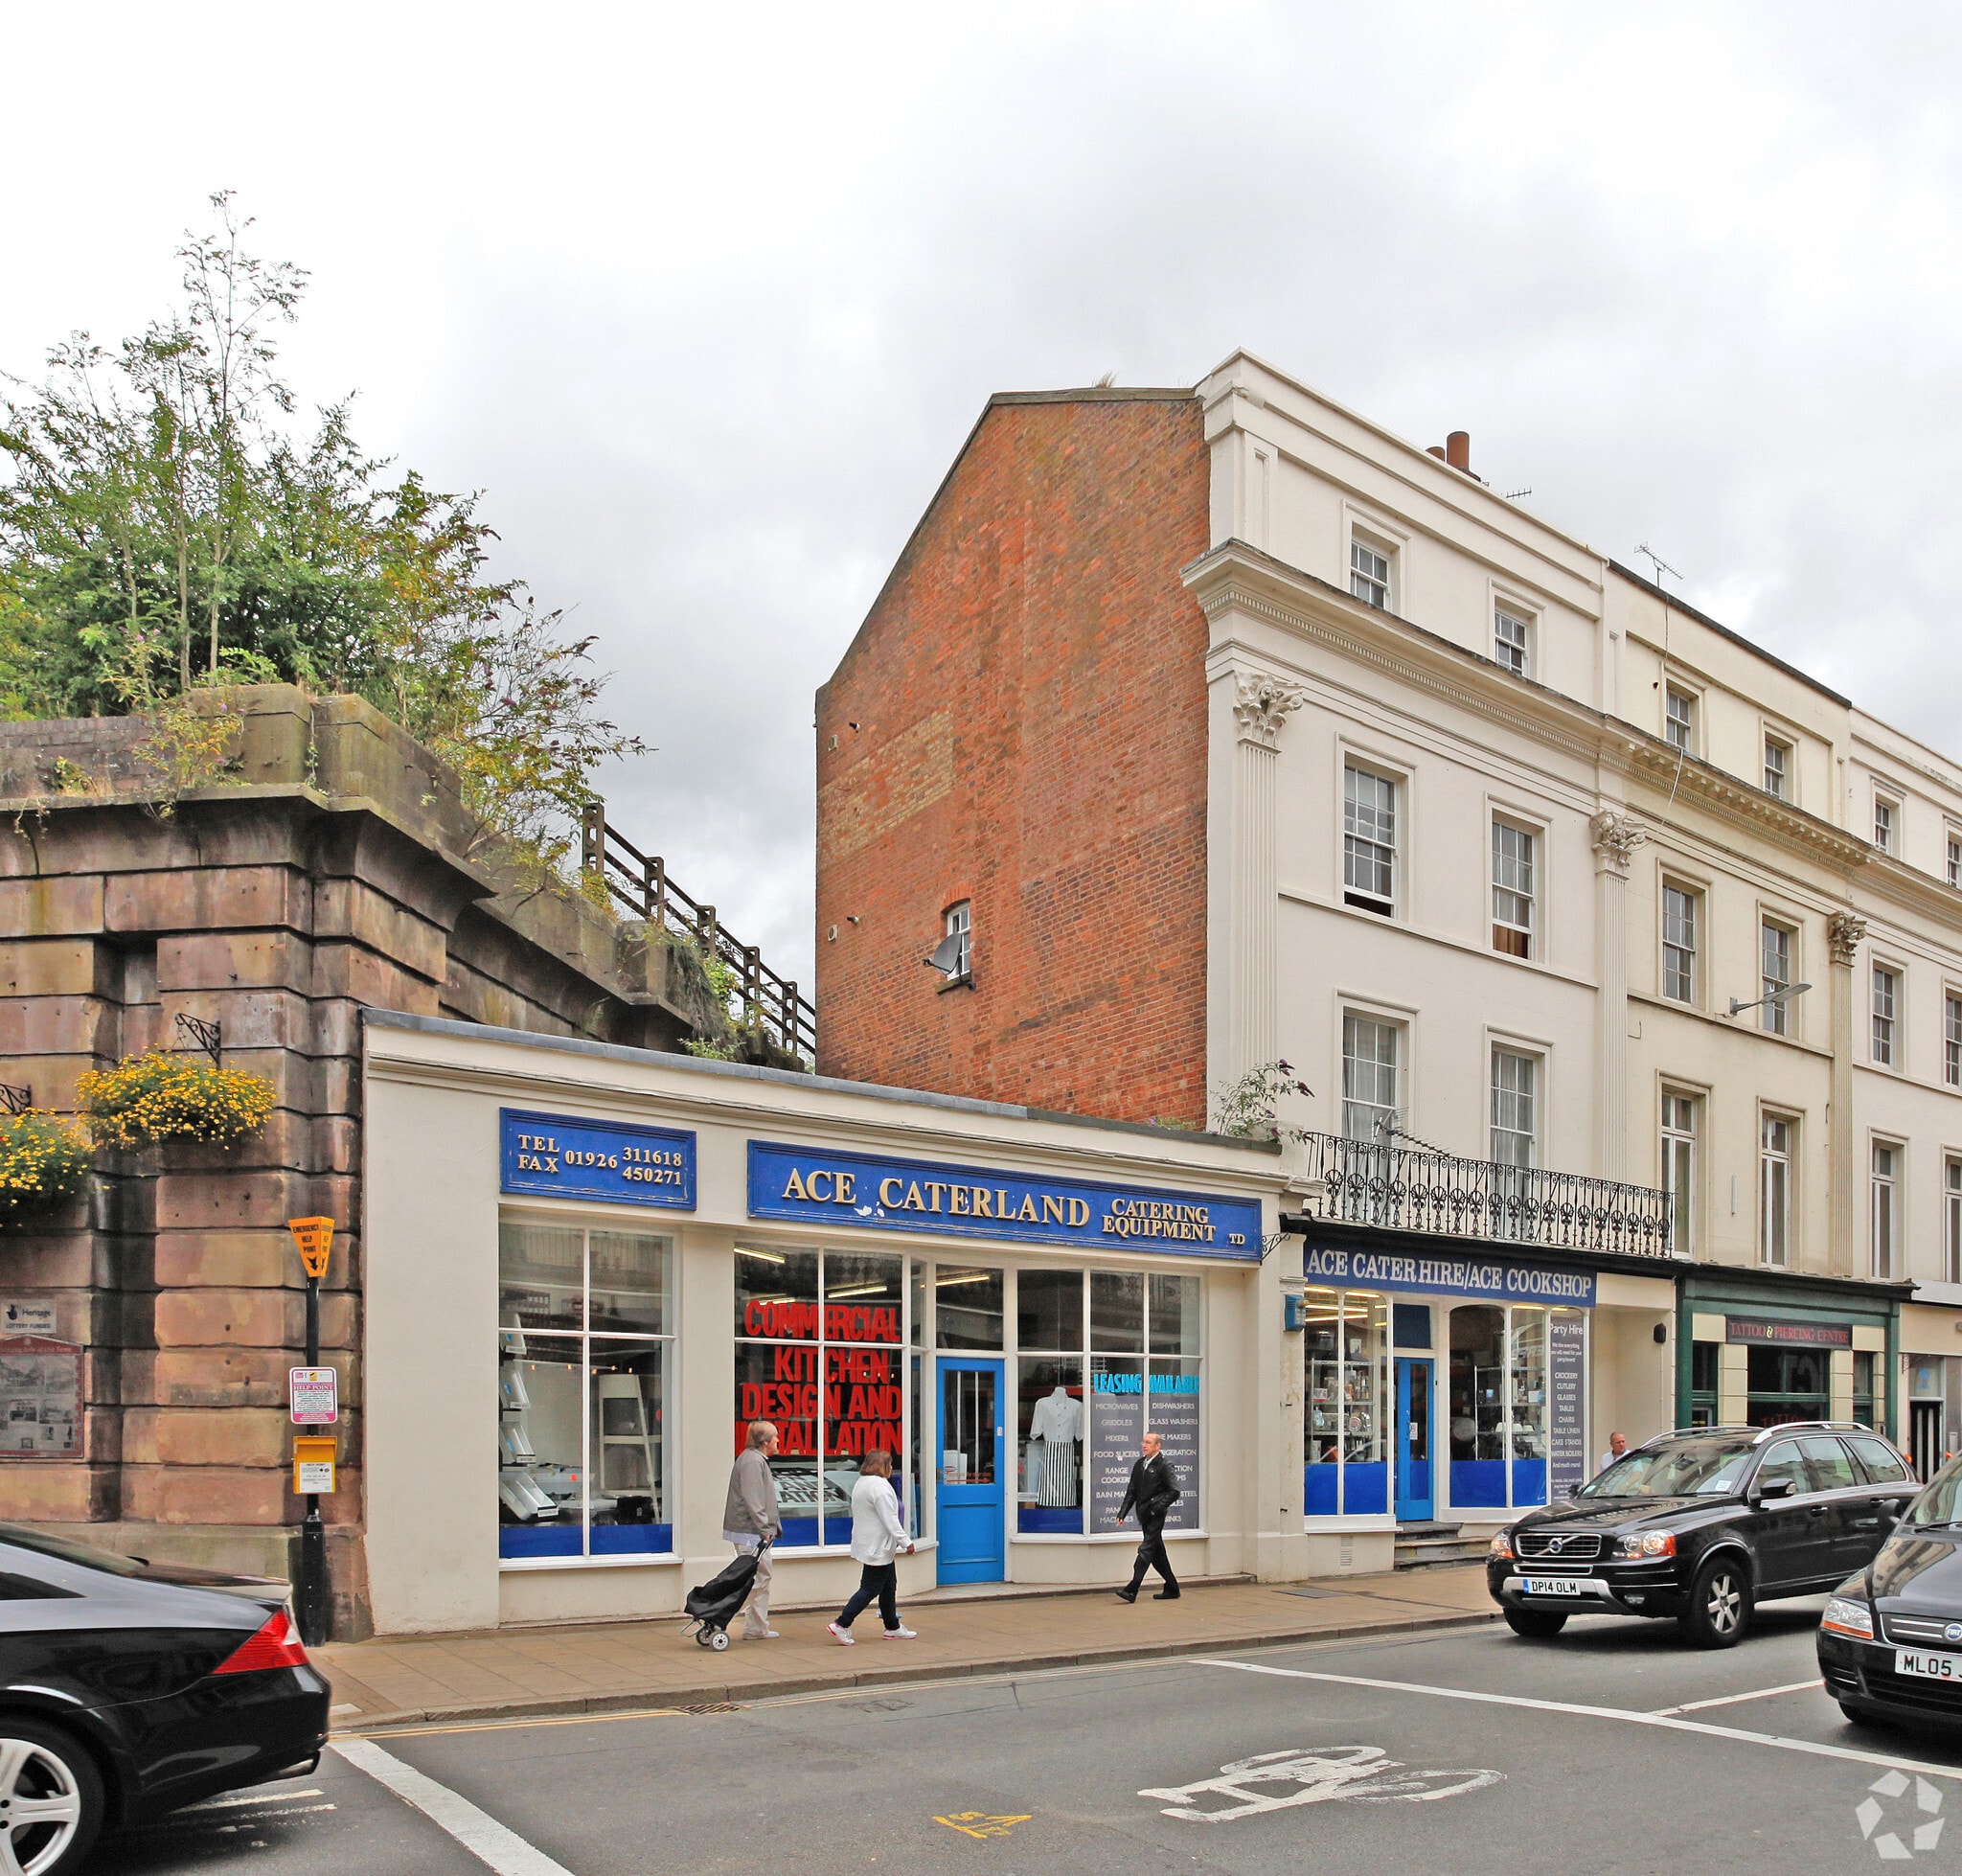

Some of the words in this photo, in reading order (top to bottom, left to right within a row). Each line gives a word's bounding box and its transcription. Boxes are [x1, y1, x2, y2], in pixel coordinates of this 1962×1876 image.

[518, 1134, 560, 1153] TEL
[565, 1150, 618, 1169] 01926
[623, 1147, 682, 1167] 311618
[518, 1155, 559, 1173] FAX
[623, 1166, 682, 1185] 450271
[782, 1168, 856, 1204] ACE
[878, 1178, 1090, 1227] CATERLAND
[1111, 1199, 1209, 1224] CATERING
[292, 1224, 320, 1233] EMERGENCY
[1102, 1215, 1216, 1243] EQUIPMENT
[1307, 1248, 1347, 1275] ACE
[1506, 1269, 1591, 1297] COOKSHOP
[22, 1309, 51, 1318] Heritage
[744, 1300, 901, 1341] COMMERCIAL
[1568, 1324, 1584, 1335] Hire
[1730, 1323, 1766, 1337] TATTOO
[1774, 1326, 1814, 1340] PIERCING
[1817, 1330, 1849, 1342] CENTRE
[774, 1346, 888, 1384] KITCHEN
[1093, 1373, 1142, 1393] LEASING
[1150, 1375, 1199, 1393] AVAILABL
[742, 1383, 841, 1420] DESIGN
[848, 1384, 901, 1420] AND
[1532, 1581, 1554, 1591] DP14
[1556, 1582, 1577, 1593] OLM
[1904, 1655, 1951, 1677] ML05
